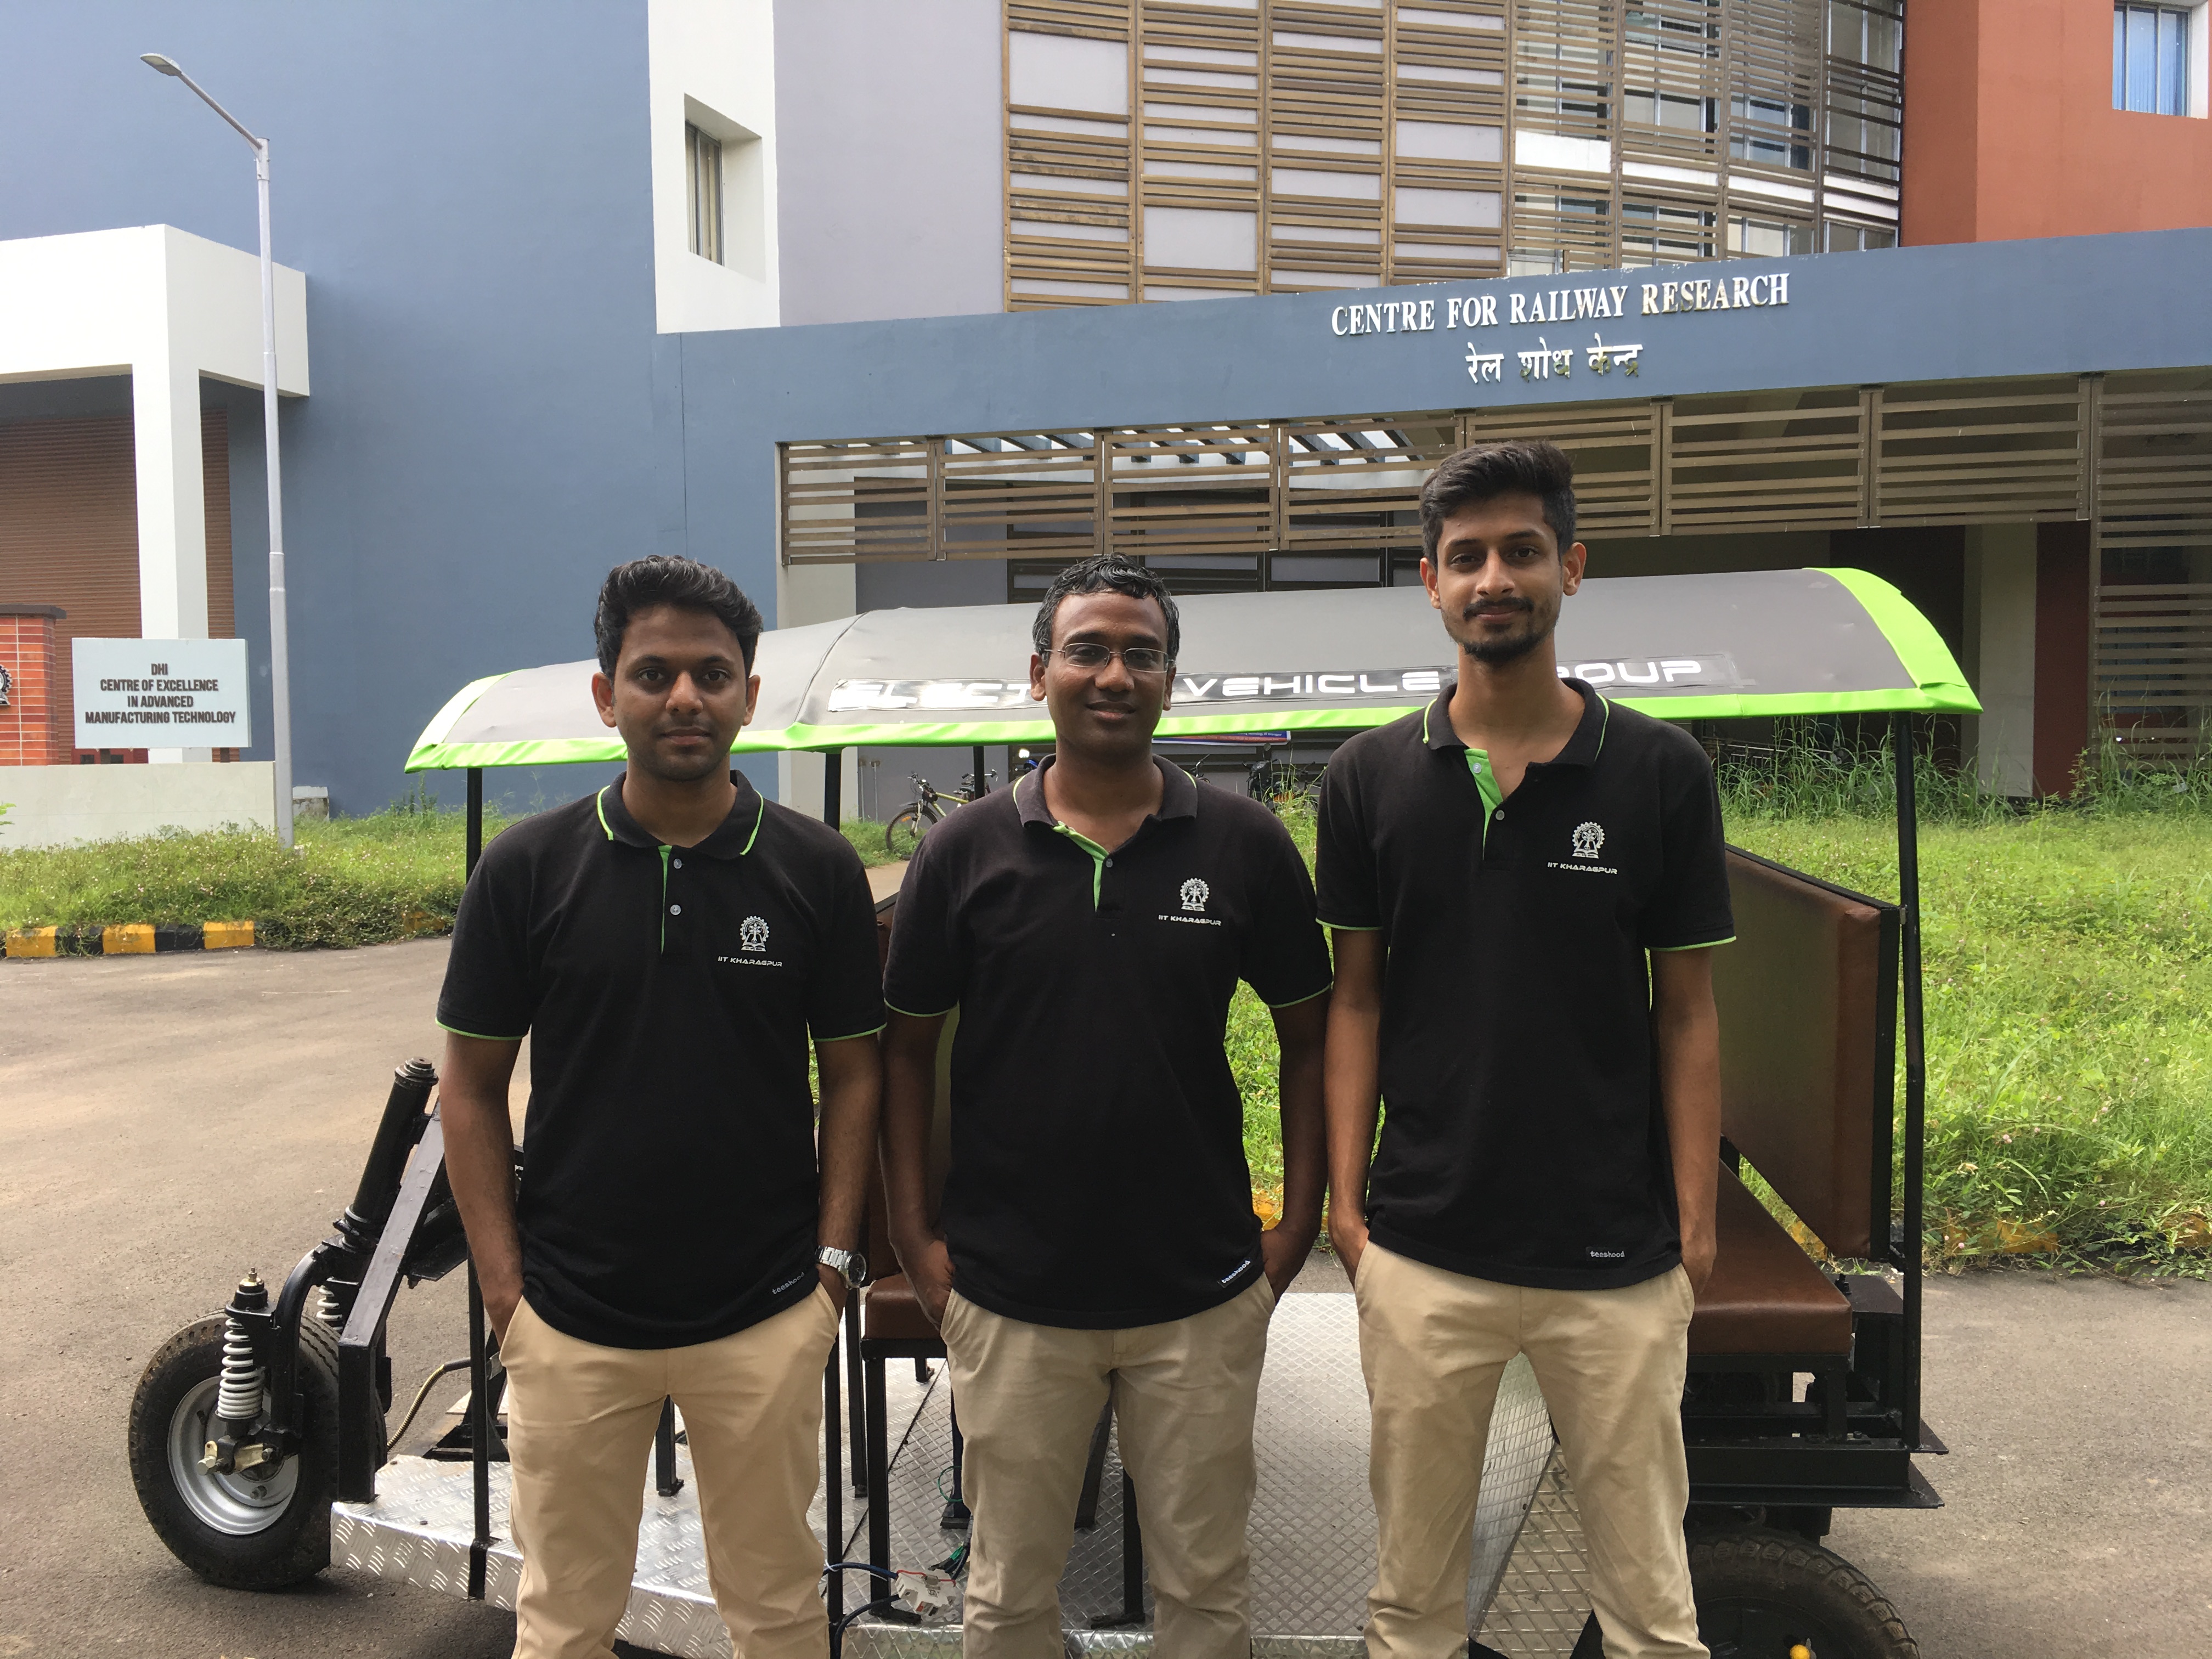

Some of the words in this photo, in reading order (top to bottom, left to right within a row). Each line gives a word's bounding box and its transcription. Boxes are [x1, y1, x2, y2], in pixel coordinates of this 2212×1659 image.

[1331, 300, 1435, 336] CENTRE
[1447, 296, 1498, 329] FOR
[1510, 285, 1628, 324] RAILWAY
[1641, 273, 1790, 315] RESEARCH
[1465, 342, 1505, 385] रेल
[1517, 336, 1573, 383] शोध
[151, 663, 168, 676] DHI
[1183, 671, 1441, 697] VEHICLE
[1556, 660, 1701, 684] OUP
[100, 679, 139, 692] CENTRE
[142, 679, 154, 691] OF
[156, 679, 218, 691] EXCELLENCE
[127, 696, 138, 707] IN
[140, 695, 193, 707] ADVANCED
[85, 712, 170, 724] MANUFACTURING
[172, 711, 236, 723] TECHNOLOGY
[1560, 863, 1618, 874] KHARAGPUR
[1170, 916, 1222, 926] KHARAGPUR
[730, 957, 783, 967] KHARAGPUR
[772, 1272, 805, 1295] teeshood
